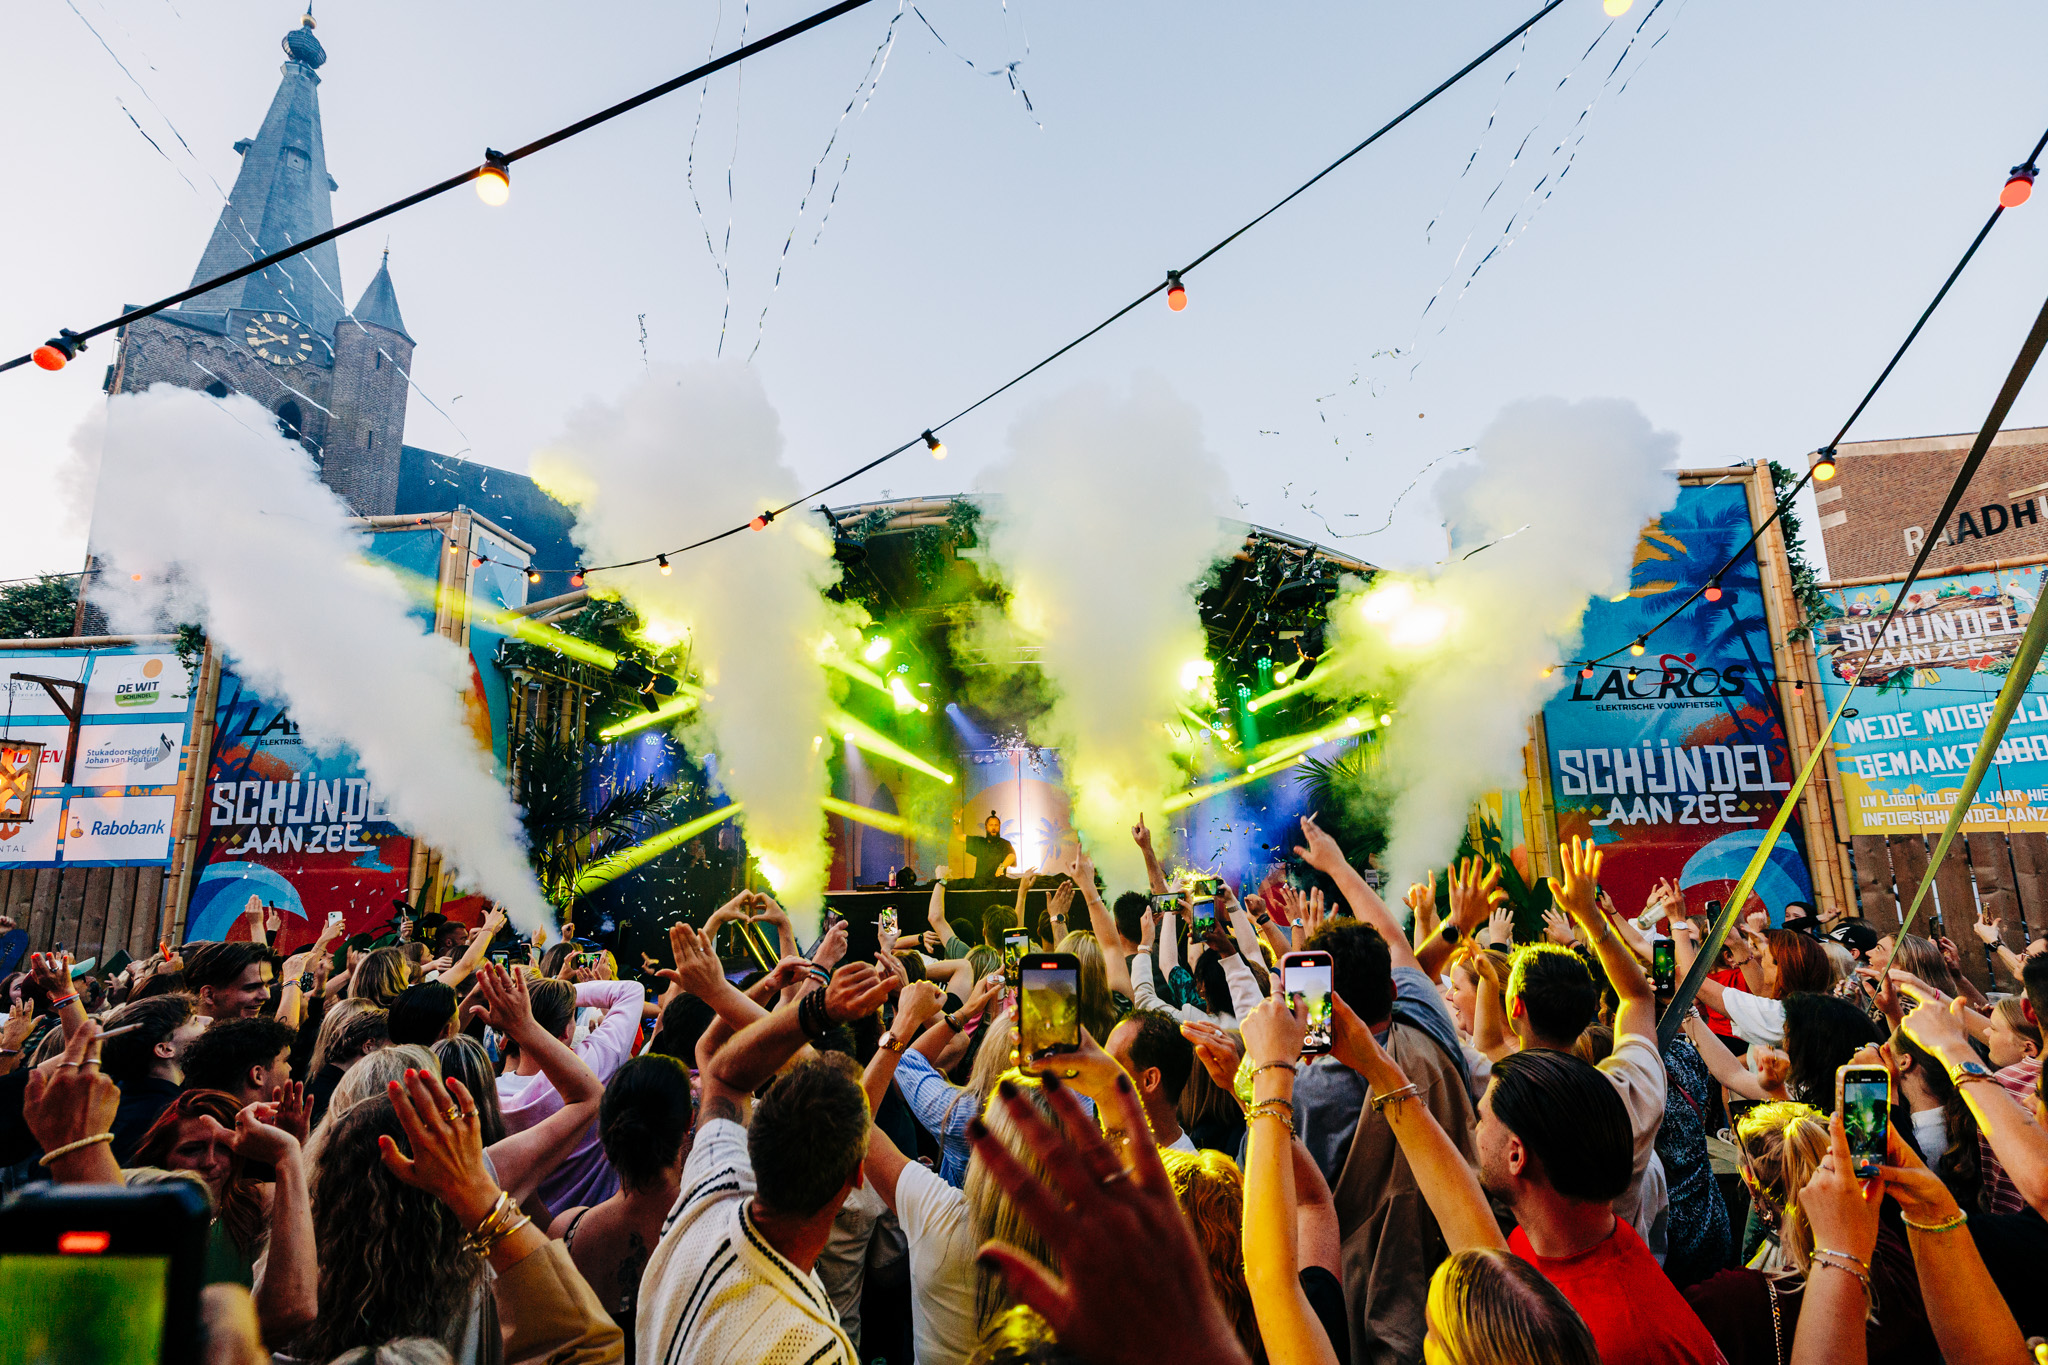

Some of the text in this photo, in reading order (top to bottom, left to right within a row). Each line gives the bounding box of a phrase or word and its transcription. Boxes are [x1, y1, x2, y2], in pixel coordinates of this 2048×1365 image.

[1840, 606, 2027, 652] SCHIJNDEL
[1865, 639, 2002, 669] AAN ZEE
[117, 681, 159, 693] DE WIT
[1568, 664, 1748, 701] LACROS
[1596, 701, 1722, 711] ELEKTRISCHE VOUWFIETSEN
[1845, 712, 1918, 743] MEDE
[85, 756, 109, 764] Johan
[128, 755, 159, 763] Houtum
[87, 746, 158, 757] Stukadoorsbedrijf
[1558, 739, 1791, 796] SCHIJNDEL
[1588, 794, 1759, 826] AAN ZEE
[1859, 795, 1877, 808] UW
[1881, 794, 1916, 807] LOGO
[1985, 789, 2022, 803] JAAR
[91, 819, 165, 836] Rabobank
[1862, 805, 2048, 827] INFO@SCHINDELAANZ
[225, 825, 376, 854] AAN ZEE
